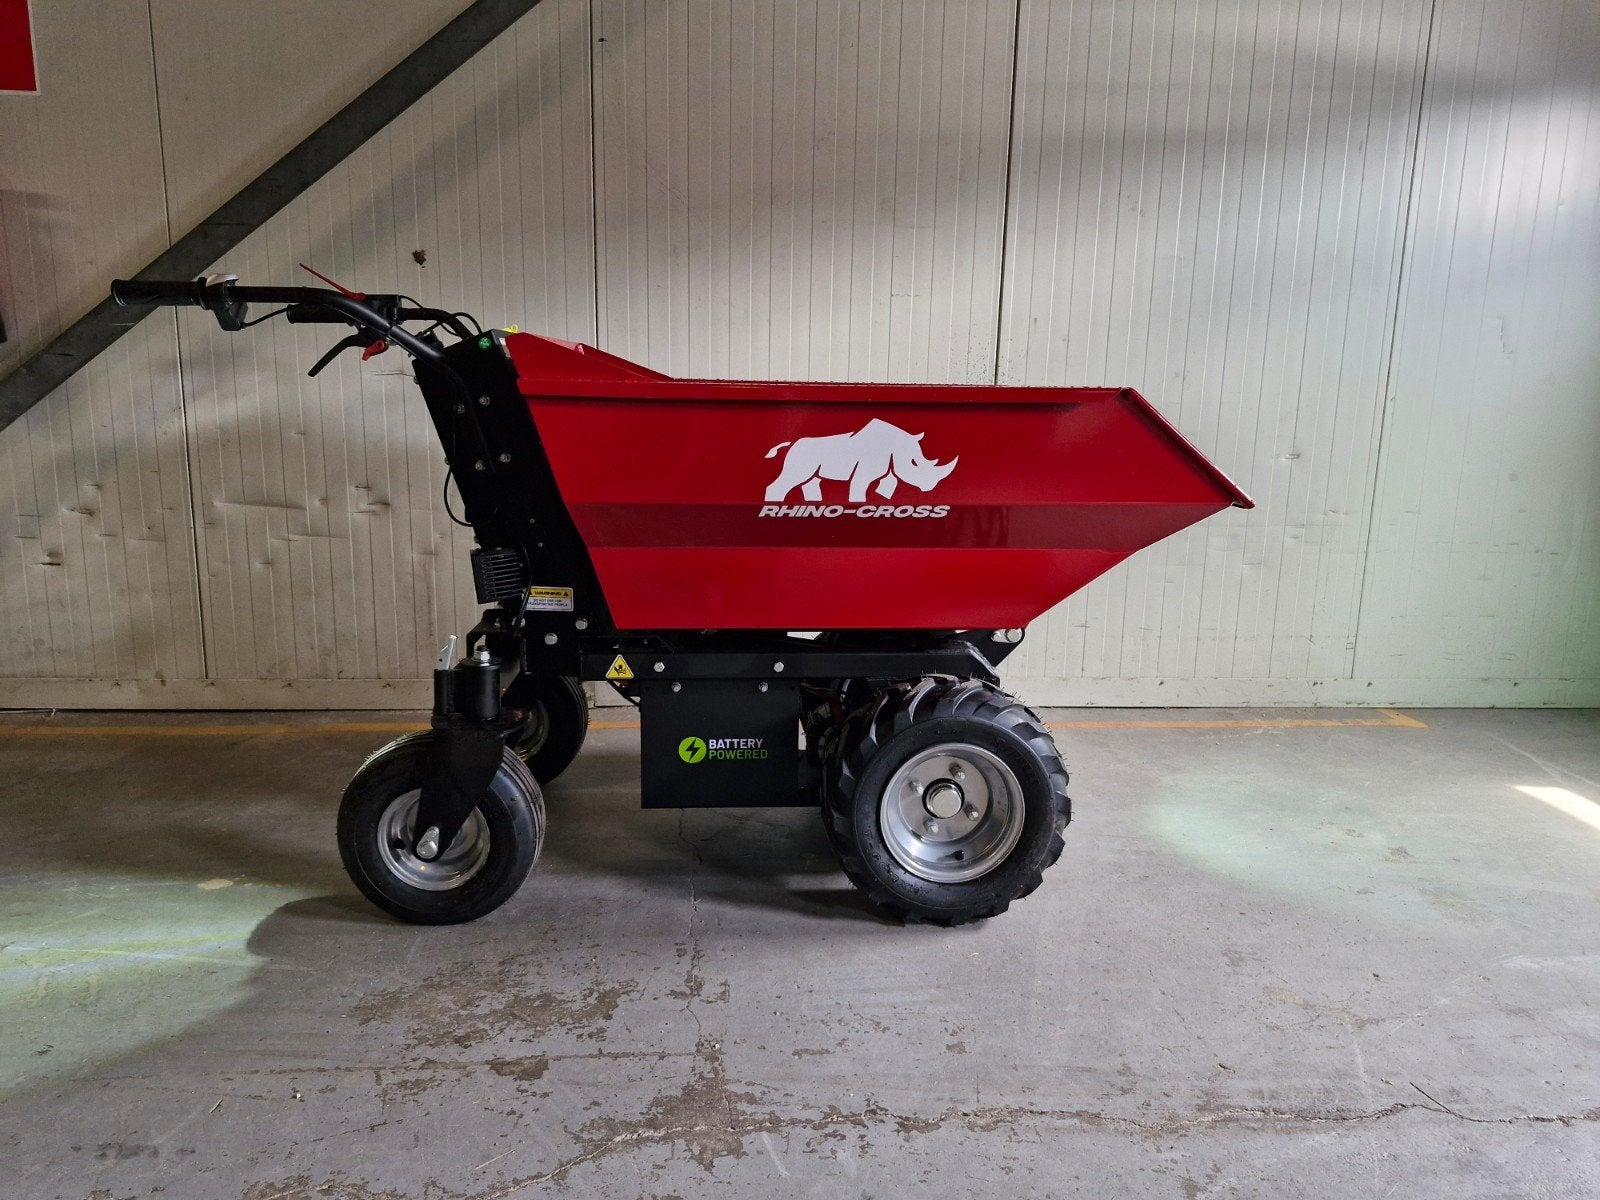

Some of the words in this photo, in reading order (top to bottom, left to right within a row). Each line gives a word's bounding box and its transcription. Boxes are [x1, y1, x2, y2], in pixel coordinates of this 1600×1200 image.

[758, 505, 950, 518] RHINO-CROSS
[709, 738, 763, 749] BATTERY
[709, 749, 768, 760] POWERED
